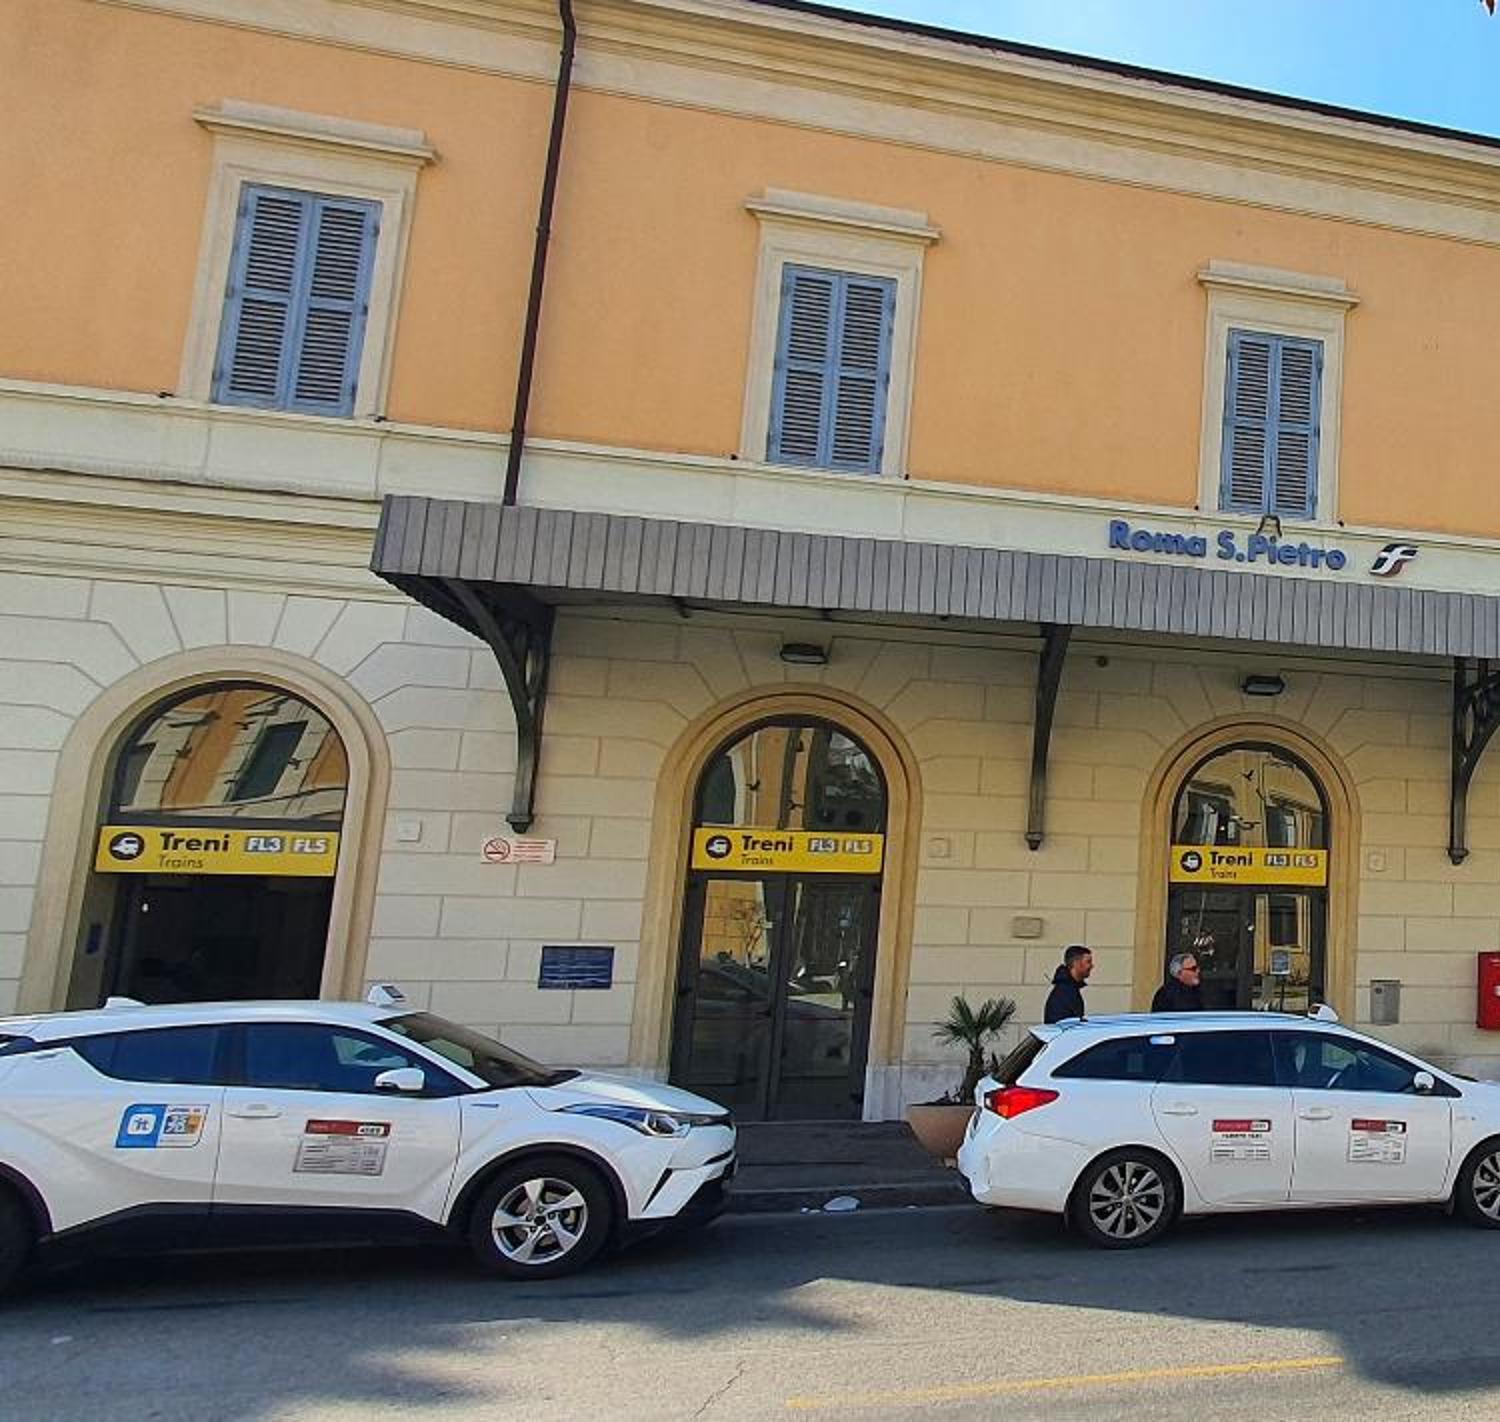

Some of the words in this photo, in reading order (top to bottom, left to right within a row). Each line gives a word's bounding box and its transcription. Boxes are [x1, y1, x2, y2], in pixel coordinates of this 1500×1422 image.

[1108, 519, 1207, 558] Roma
[160, 831, 231, 852] Treni
[247, 837, 281, 852] FL3
[293, 838, 328, 853] FL5
[741, 835, 794, 852] Treni
[809, 838, 836, 853] FL3
[158, 855, 204, 869] Trains
[741, 853, 774, 865] Trains
[1209, 851, 1253, 866] Treni
